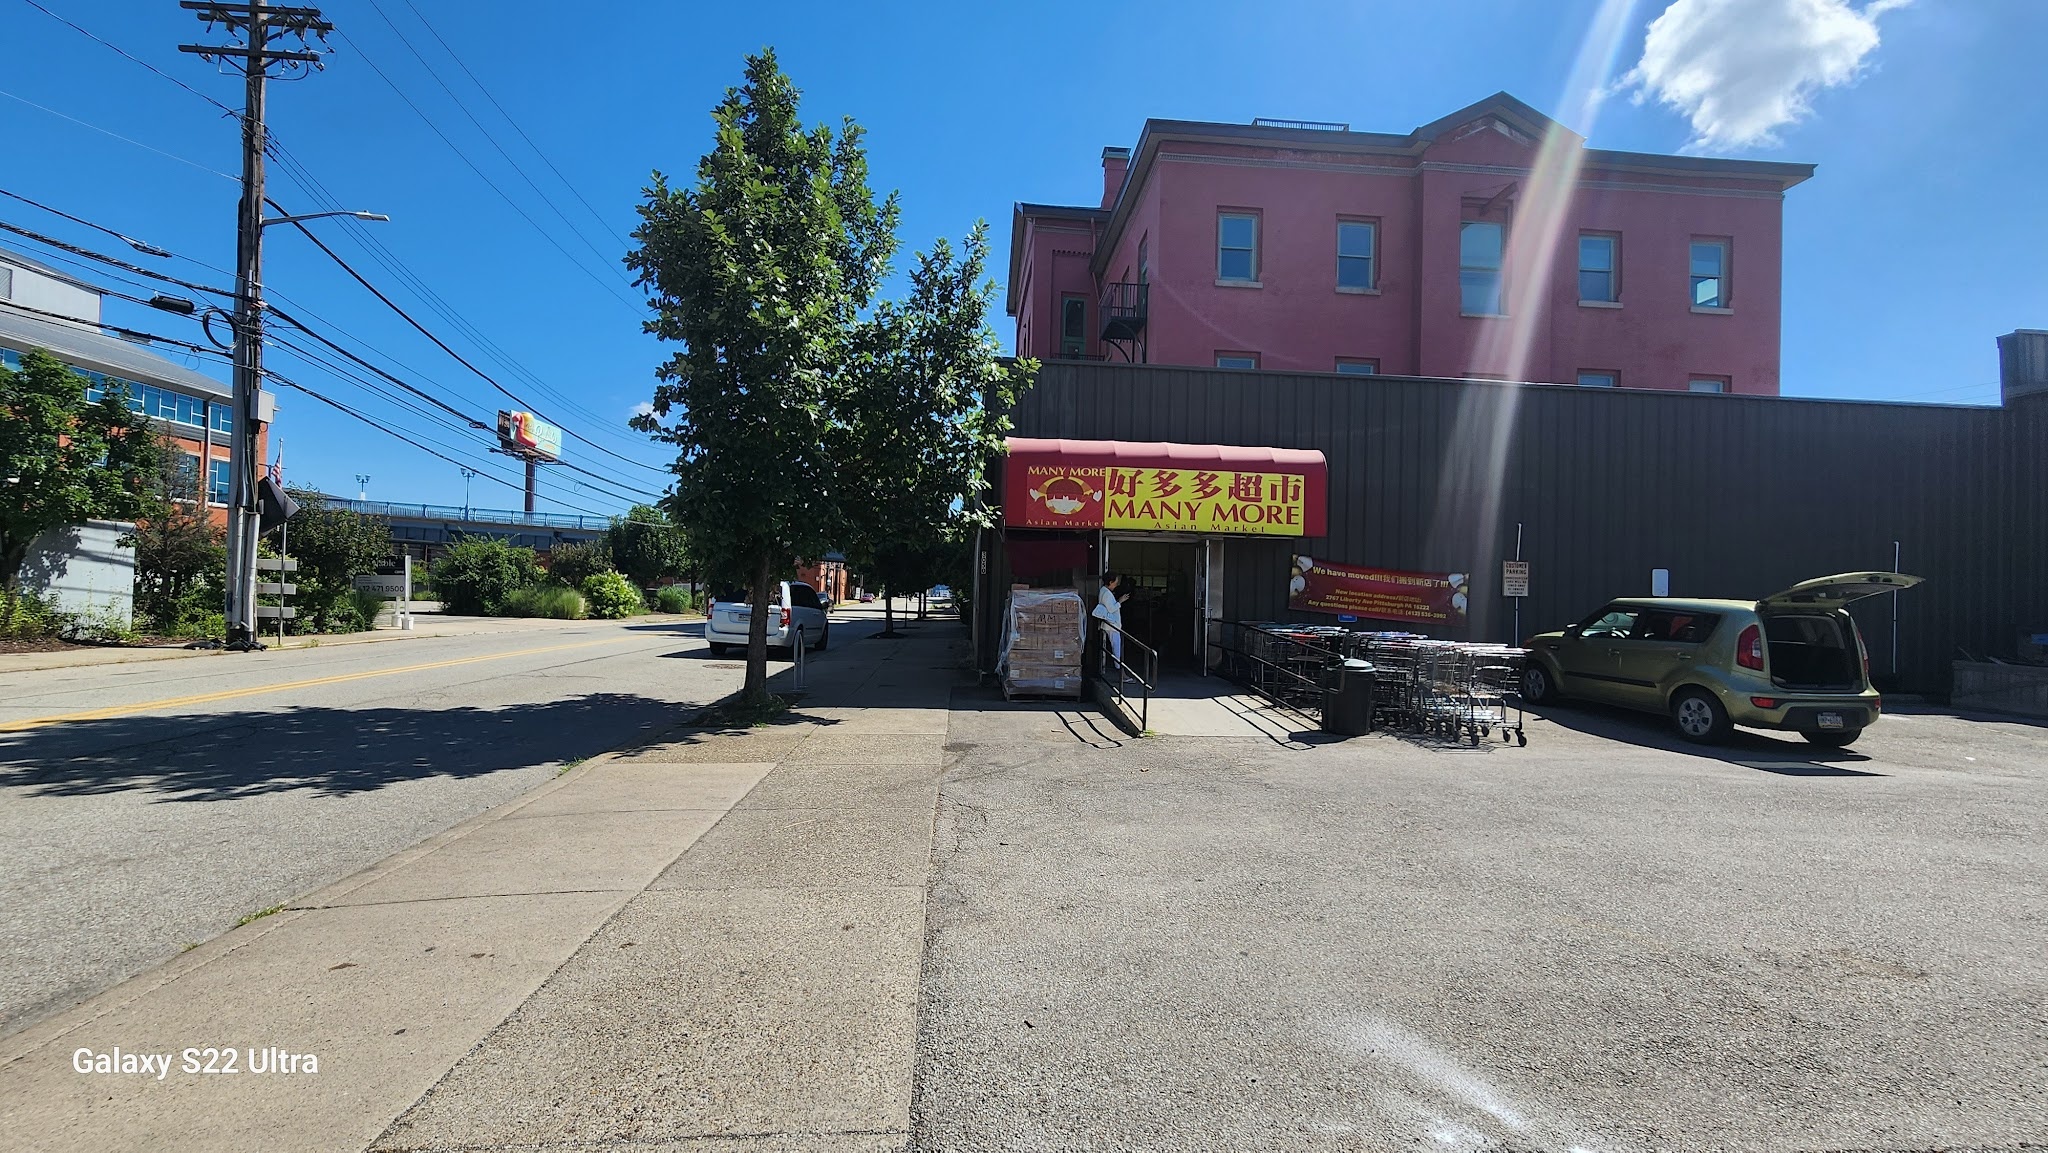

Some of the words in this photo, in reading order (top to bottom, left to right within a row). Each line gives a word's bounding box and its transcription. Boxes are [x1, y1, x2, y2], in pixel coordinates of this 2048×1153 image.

[1028, 466, 1066, 475] MANY
[1069, 468, 1105, 476] MORE
[1108, 468, 1302, 504] 好多多超市
[1108, 500, 1202, 521] MANY
[1212, 502, 1299, 525] MORE
[1154, 521, 1197, 530] Asian
[1210, 524, 1266, 533] Market
[1313, 566, 1326, 575] We
[1327, 568, 1346, 577] have
[1349, 590, 1372, 598] location
[1320, 601, 1348, 609] questions
[1340, 596, 1361, 604] Liberty
[1374, 600, 1404, 609] Pittsburgh
